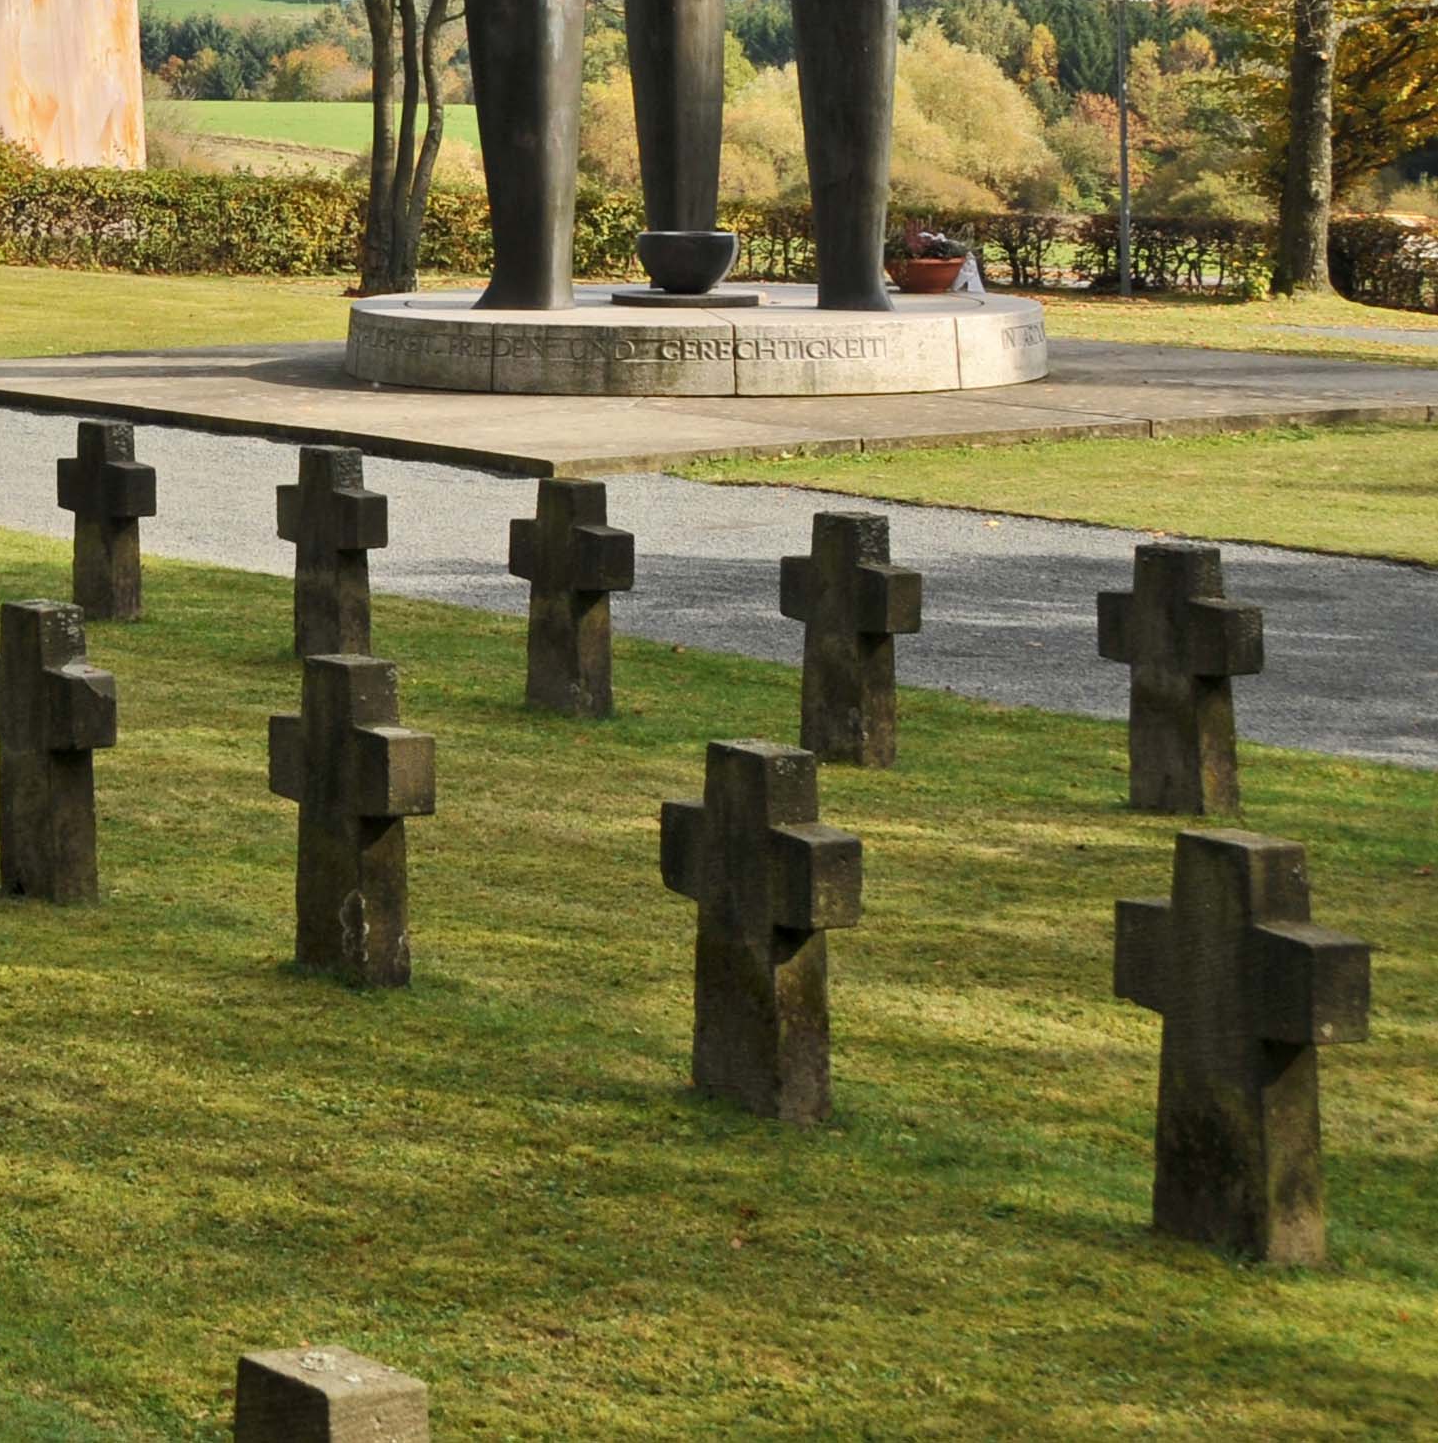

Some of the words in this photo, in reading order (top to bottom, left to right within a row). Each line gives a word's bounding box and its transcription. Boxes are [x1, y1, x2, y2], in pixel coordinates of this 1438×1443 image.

[449, 334, 544, 359] FRIEDEN
[571, 338, 635, 360] UND
[658, 337, 883, 361] GERECHTIGKEIT
